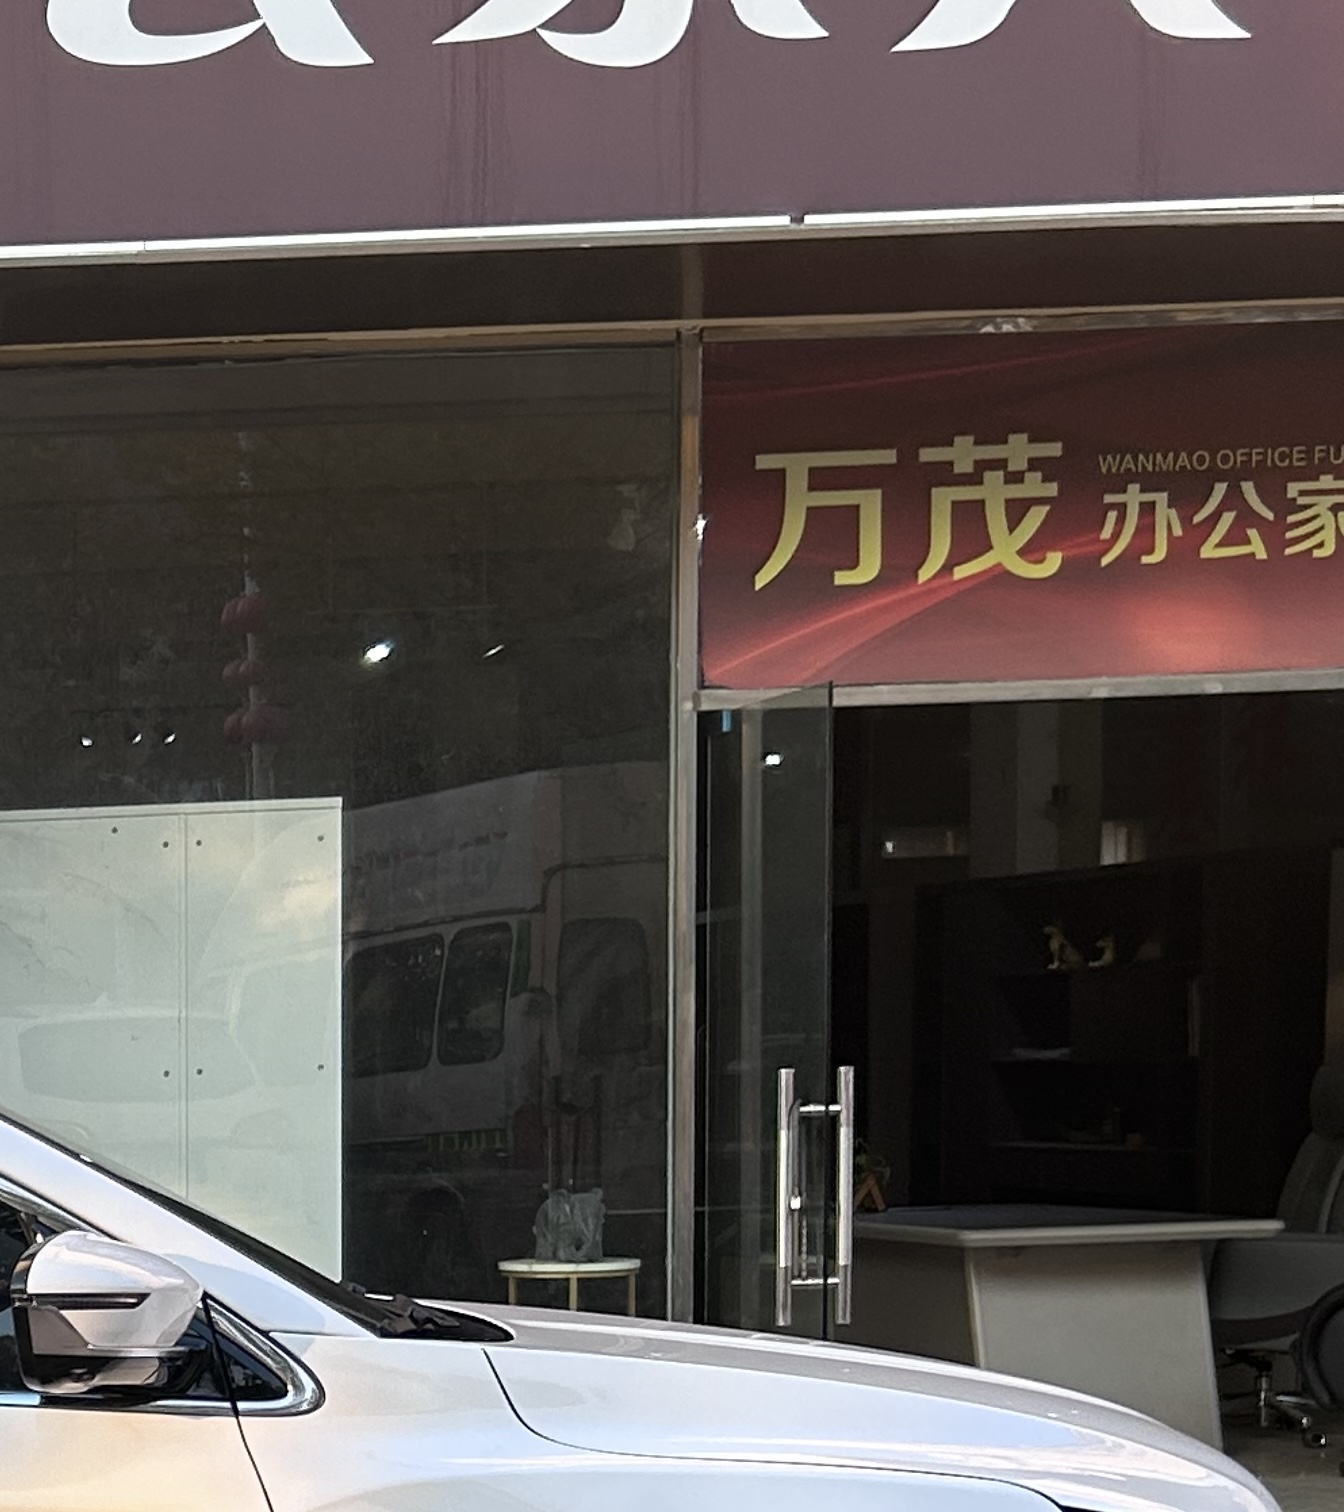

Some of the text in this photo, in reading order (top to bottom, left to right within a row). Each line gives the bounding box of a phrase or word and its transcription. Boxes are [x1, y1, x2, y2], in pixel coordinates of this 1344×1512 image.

[1098, 450, 1210, 475] WANMAO
[1216, 446, 1308, 471] OFFICE
[755, 432, 1063, 591] 万茂
